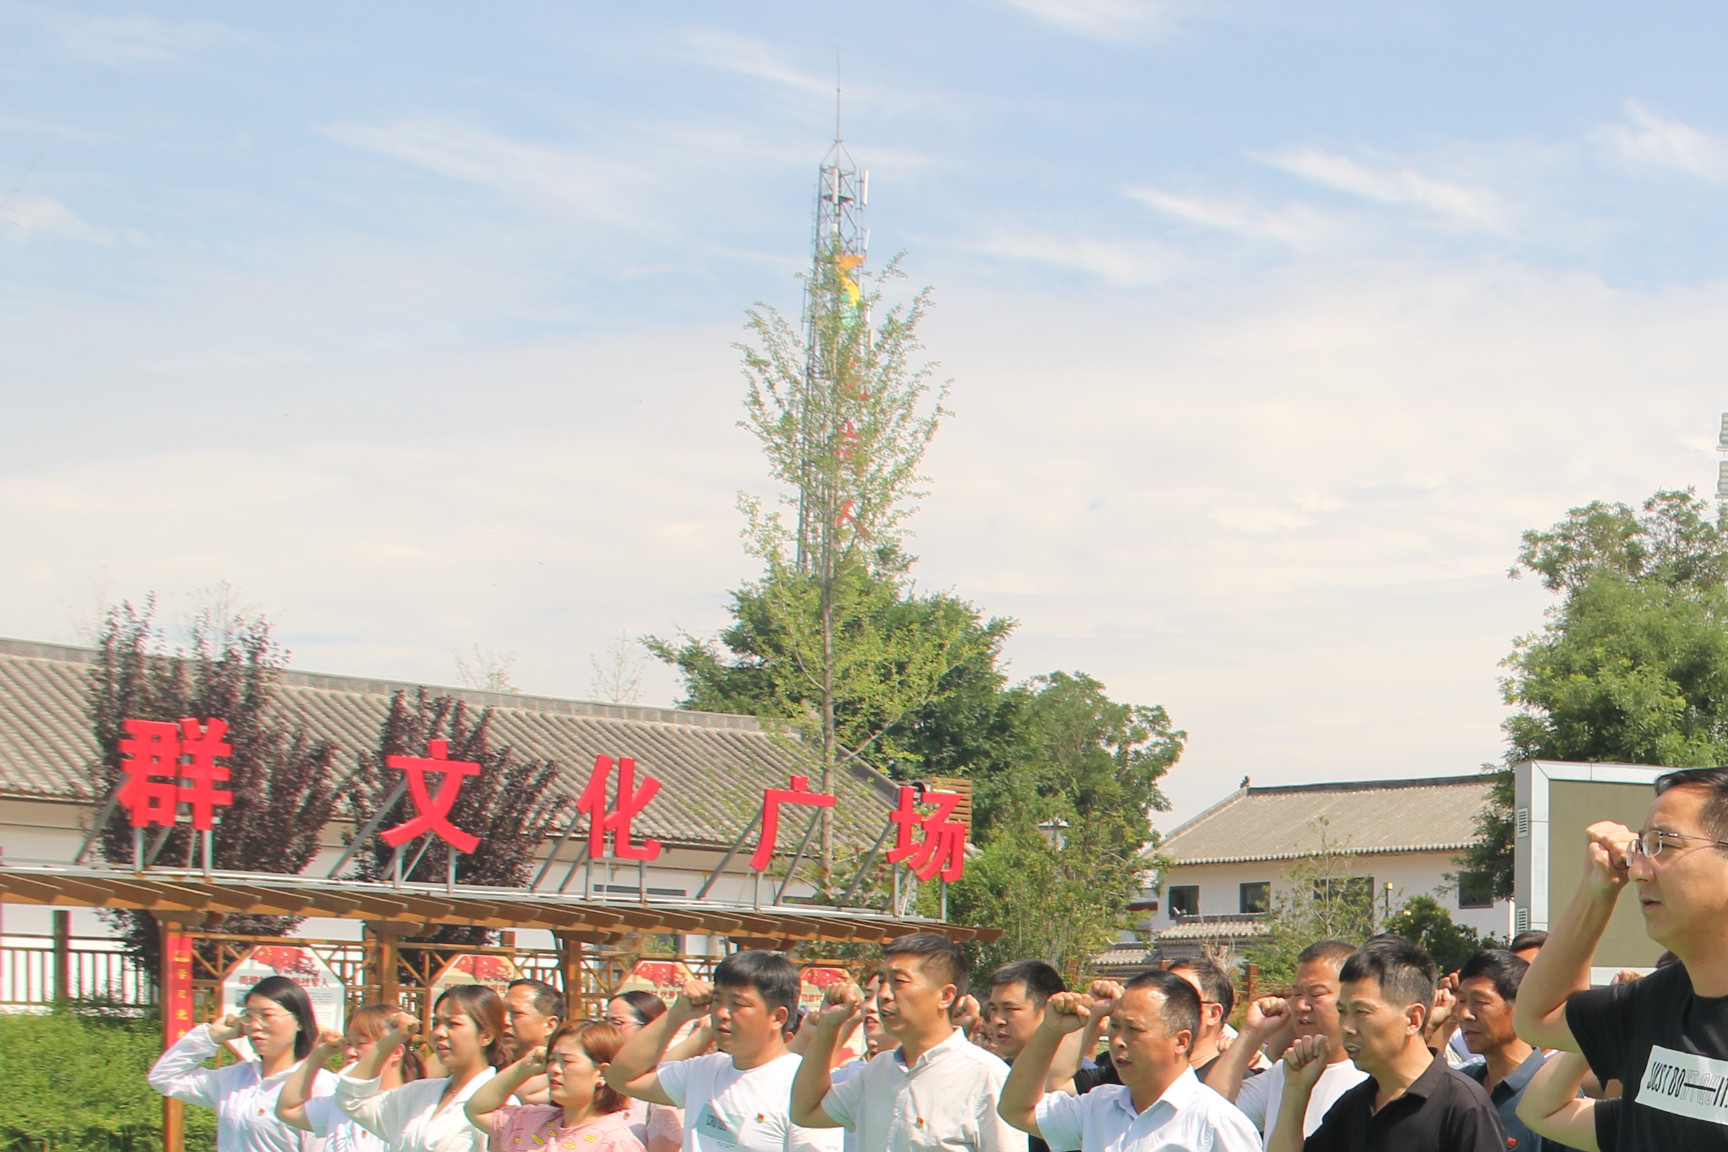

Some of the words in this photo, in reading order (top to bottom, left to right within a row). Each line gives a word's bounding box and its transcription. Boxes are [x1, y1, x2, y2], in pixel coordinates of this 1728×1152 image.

[116, 717, 966, 882] 群文化广场
